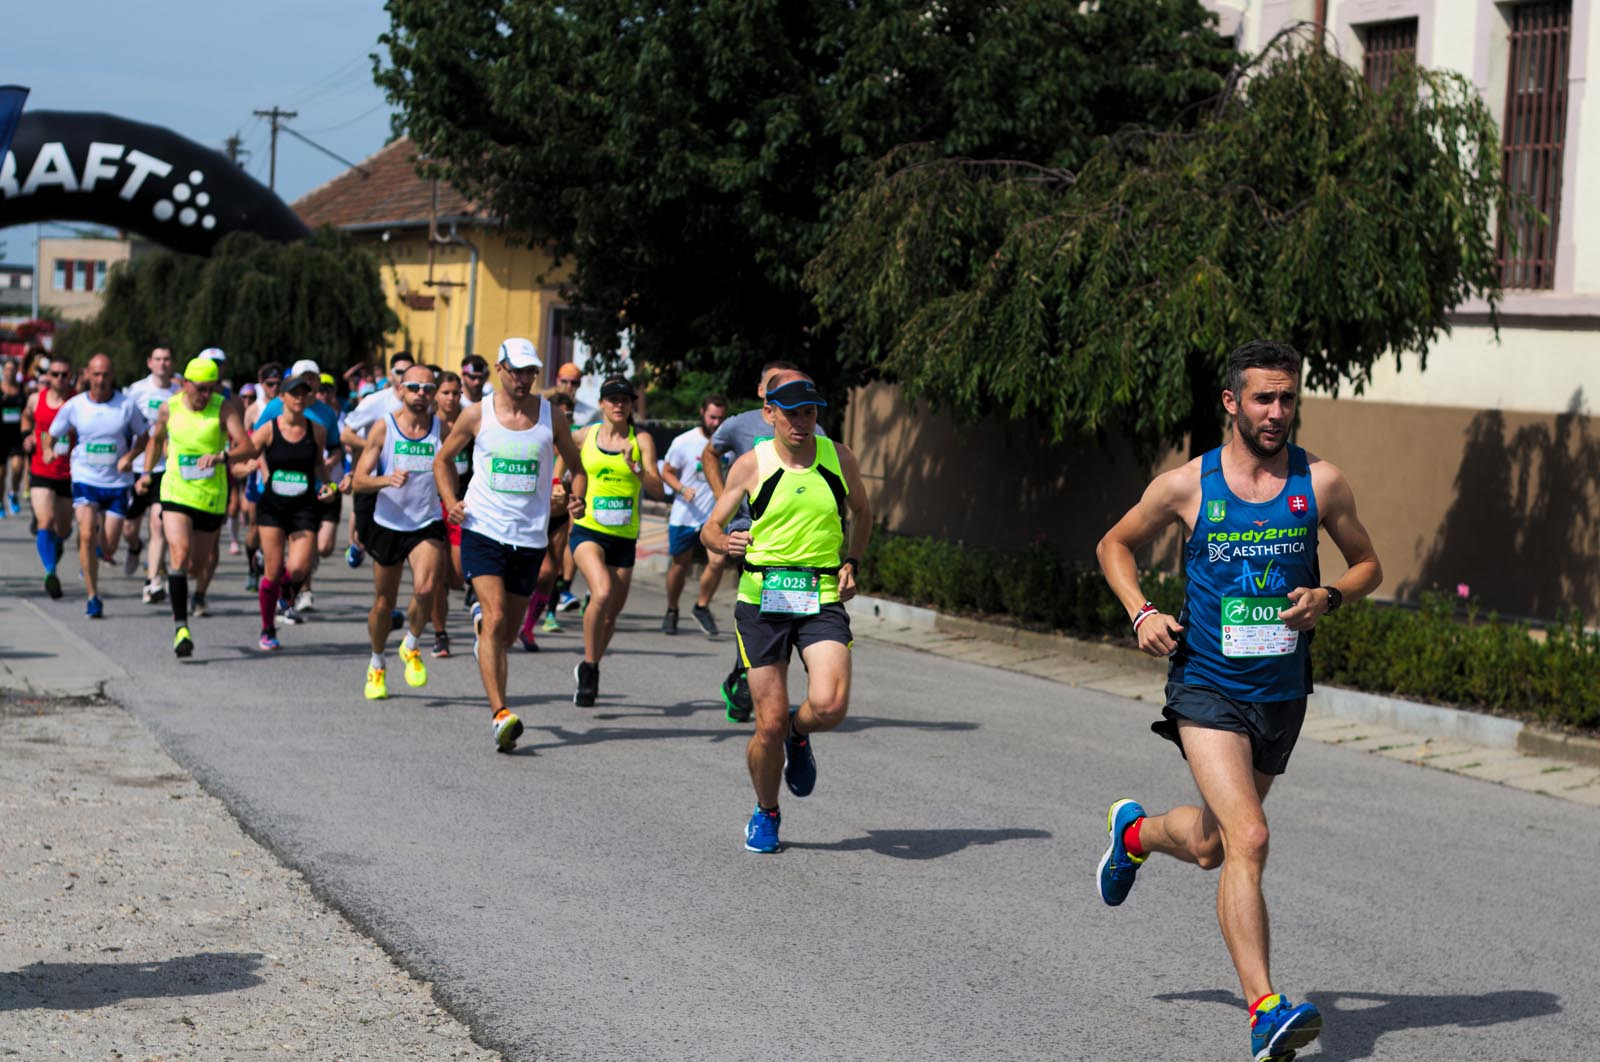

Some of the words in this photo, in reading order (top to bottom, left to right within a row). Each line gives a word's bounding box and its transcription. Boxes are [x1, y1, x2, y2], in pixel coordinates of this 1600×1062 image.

[508, 463, 527, 473] 034
[1207, 527, 1308, 543] ready2run
[1233, 543, 1305, 557] AESTHETICA
[783, 576, 806, 588] 028
